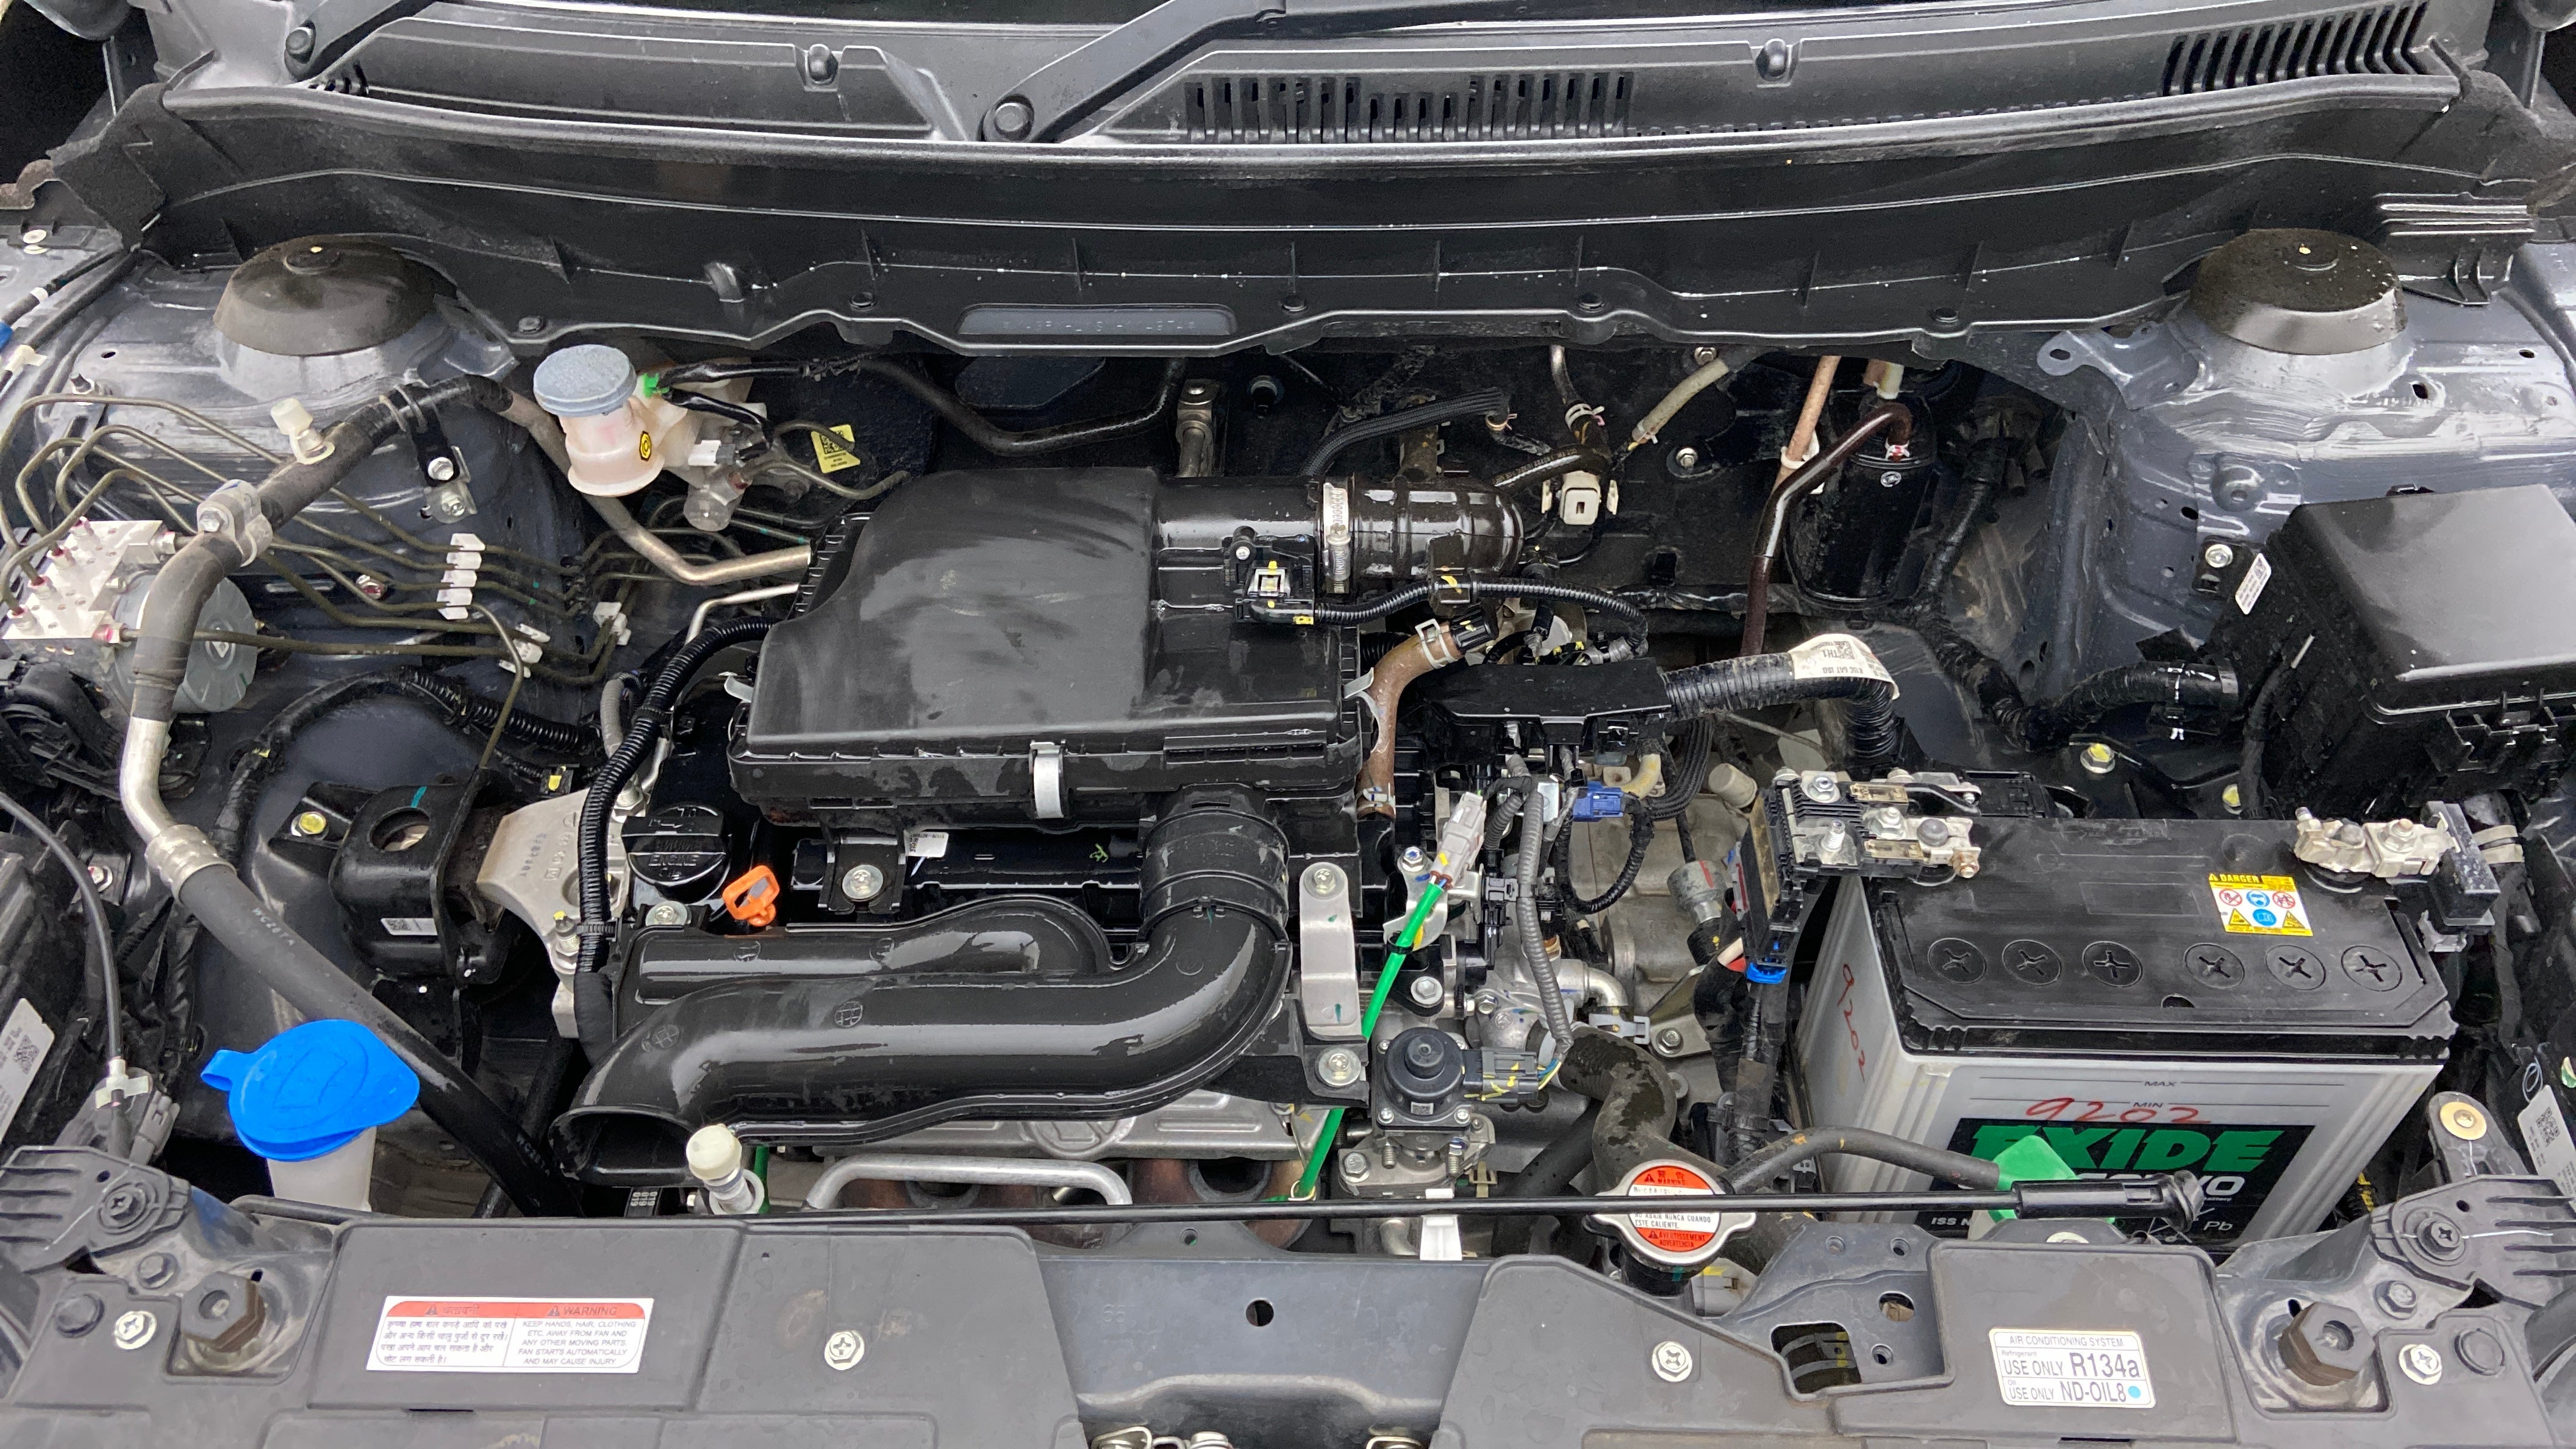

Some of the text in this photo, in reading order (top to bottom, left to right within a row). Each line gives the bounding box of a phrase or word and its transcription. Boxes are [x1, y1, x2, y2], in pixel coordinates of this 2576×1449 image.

[1822, 649, 1840, 658] TH1
[2220, 874, 2259, 883] DANGER
[2025, 1097, 2211, 1123] 9202
[1651, 1220, 1680, 1229] CALIENTE.
[1931, 1217, 1957, 1226] ISS
[2203, 1221, 2233, 1231] Pb
[1659, 1232, 1705, 1242] AVERTISSEMENT
[564, 1306, 618, 1315] WARNING
[2009, 1336, 2123, 1347] AIR CONDITIONING SYSTEM
[2003, 1353, 2141, 1378] USE ONLY R134a
[2009, 1381, 2127, 1402] USE ONLY ND-OIL8
